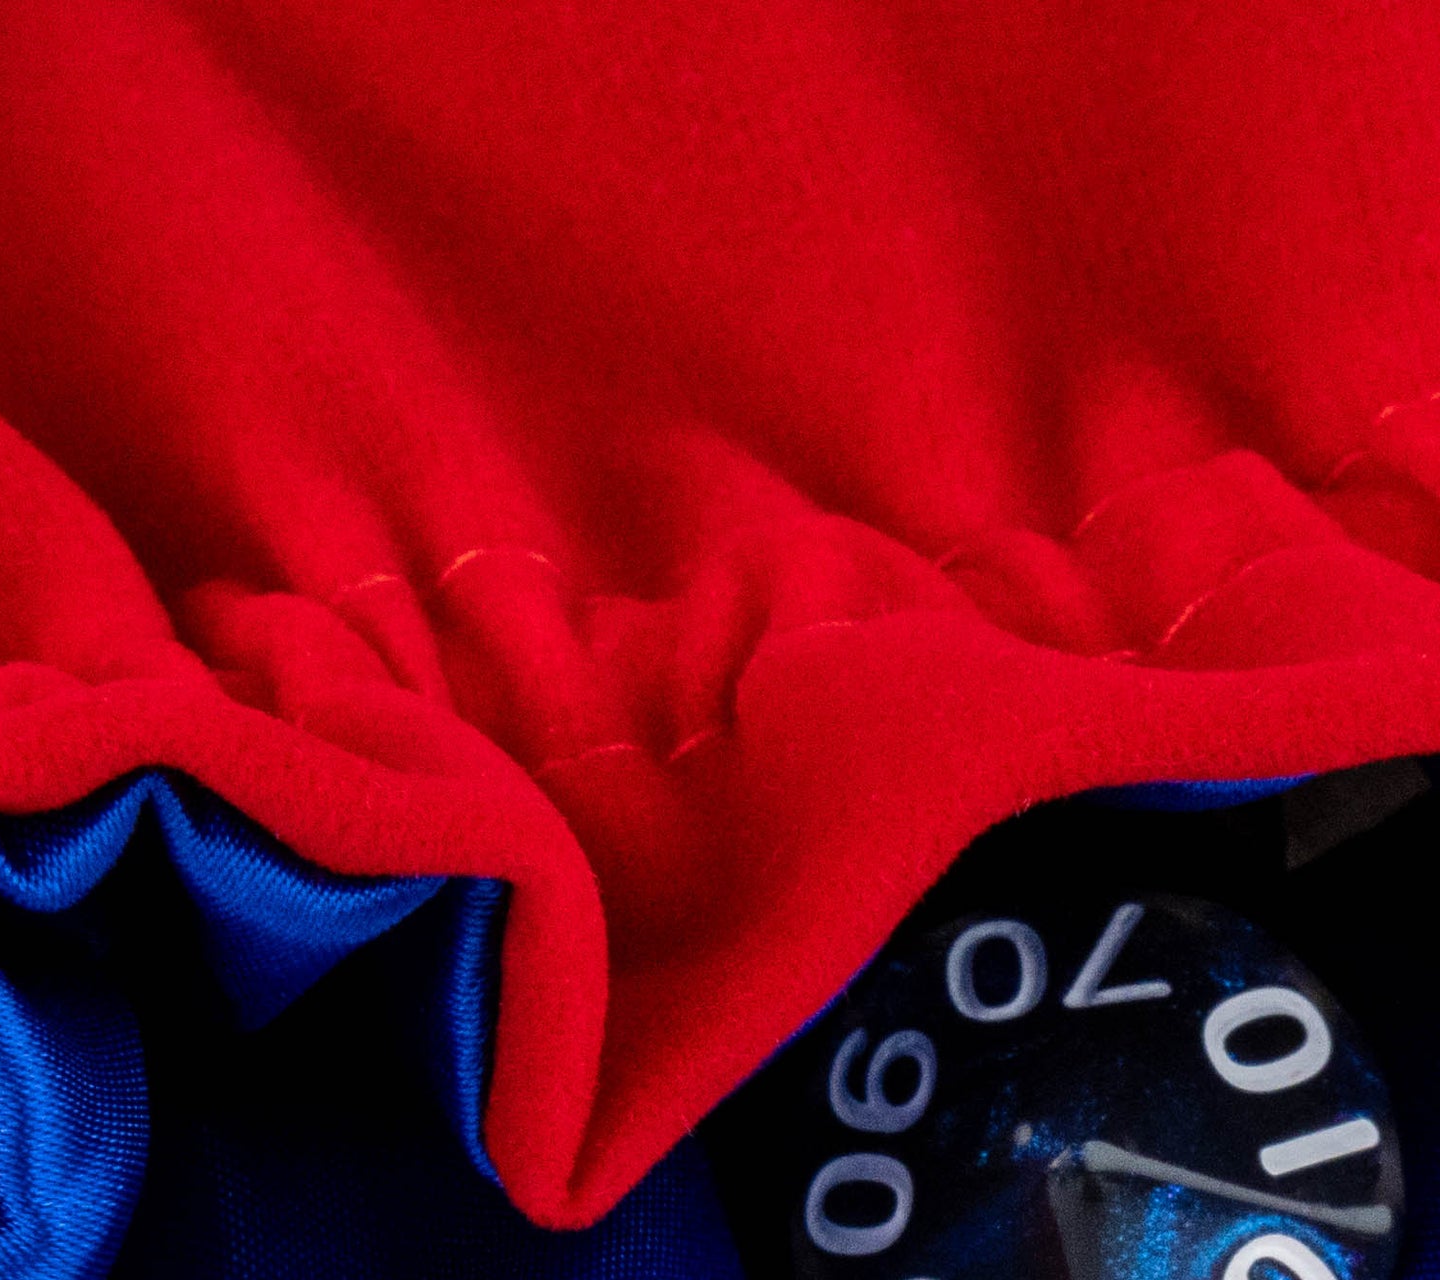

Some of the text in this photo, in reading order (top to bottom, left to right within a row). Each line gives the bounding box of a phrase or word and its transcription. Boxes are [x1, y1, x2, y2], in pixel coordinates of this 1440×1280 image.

[947, 905, 1172, 1022] 70
[804, 1028, 936, 1257] 90
[1202, 985, 1381, 1178] 10
